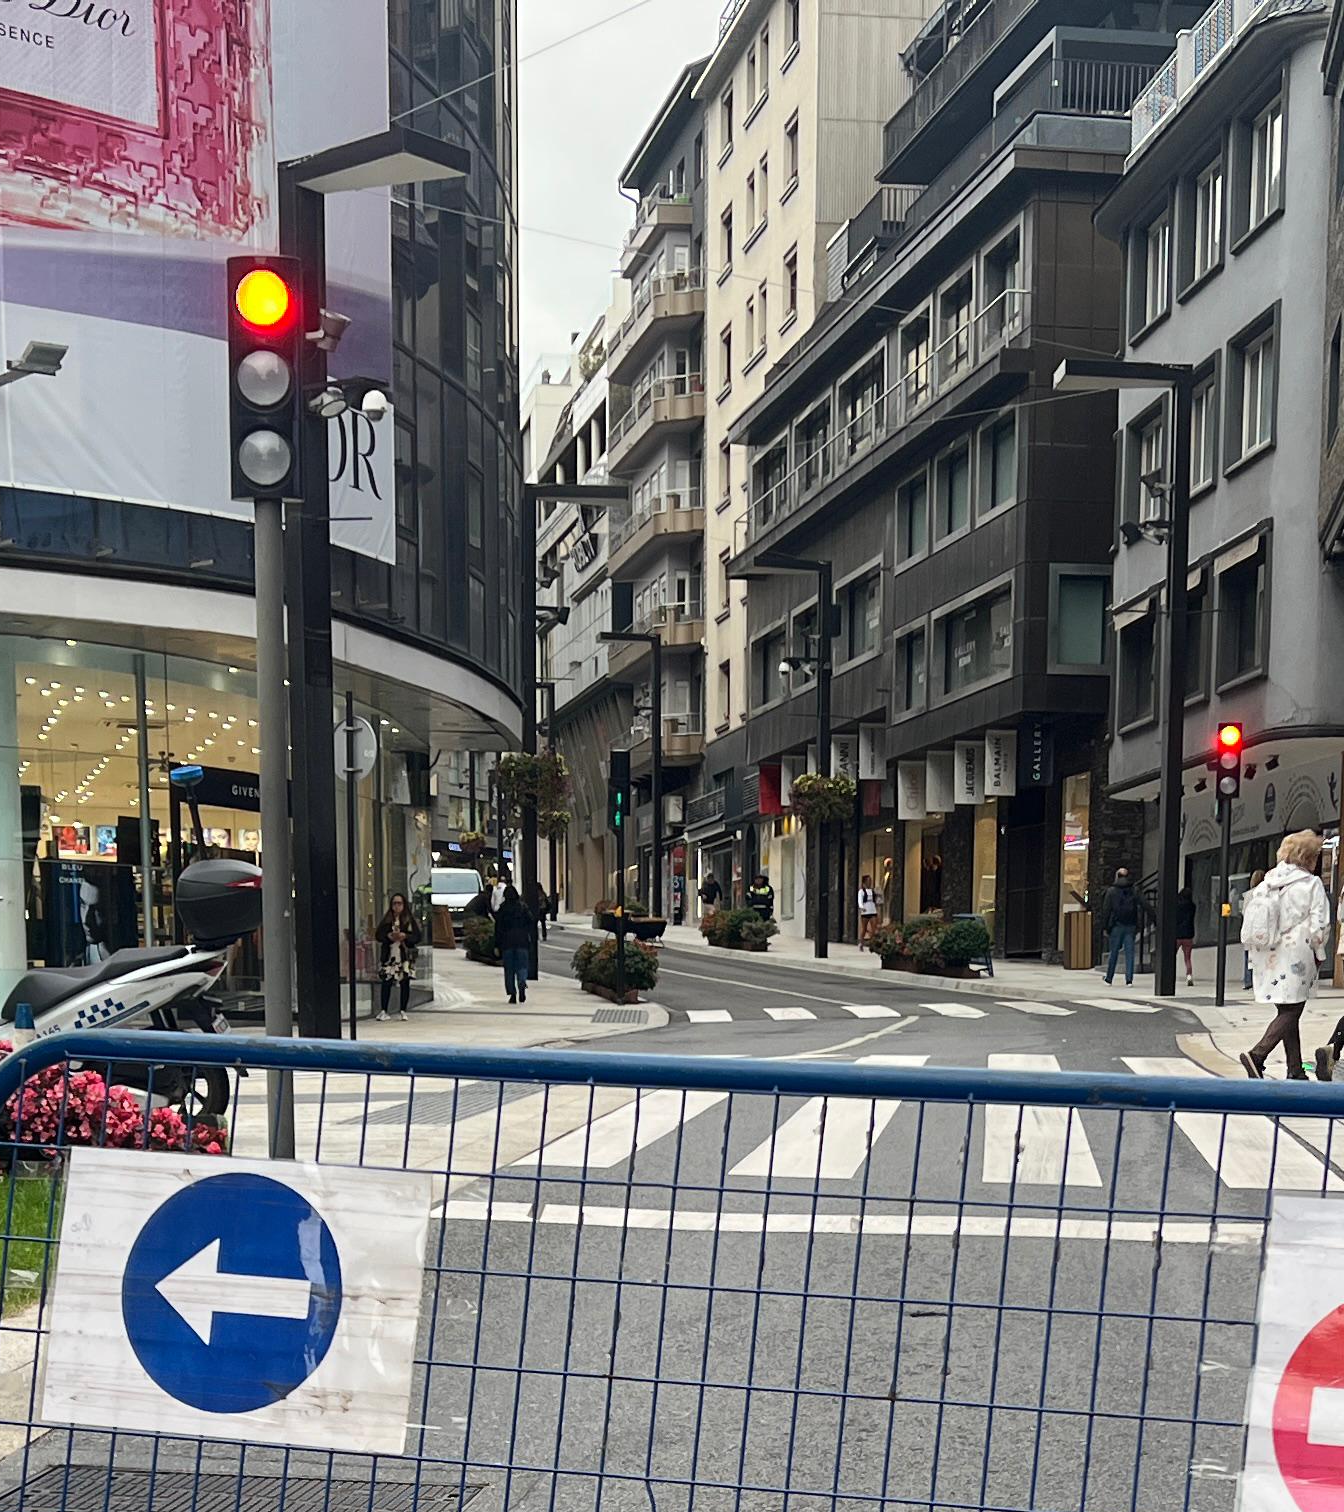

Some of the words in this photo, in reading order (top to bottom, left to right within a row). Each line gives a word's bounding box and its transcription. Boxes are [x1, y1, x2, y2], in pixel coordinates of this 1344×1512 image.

[993, 736, 1002, 787] BALMAIN
[1032, 722, 1042, 781] GALLERY
[61, 863, 83, 871] BLEU
